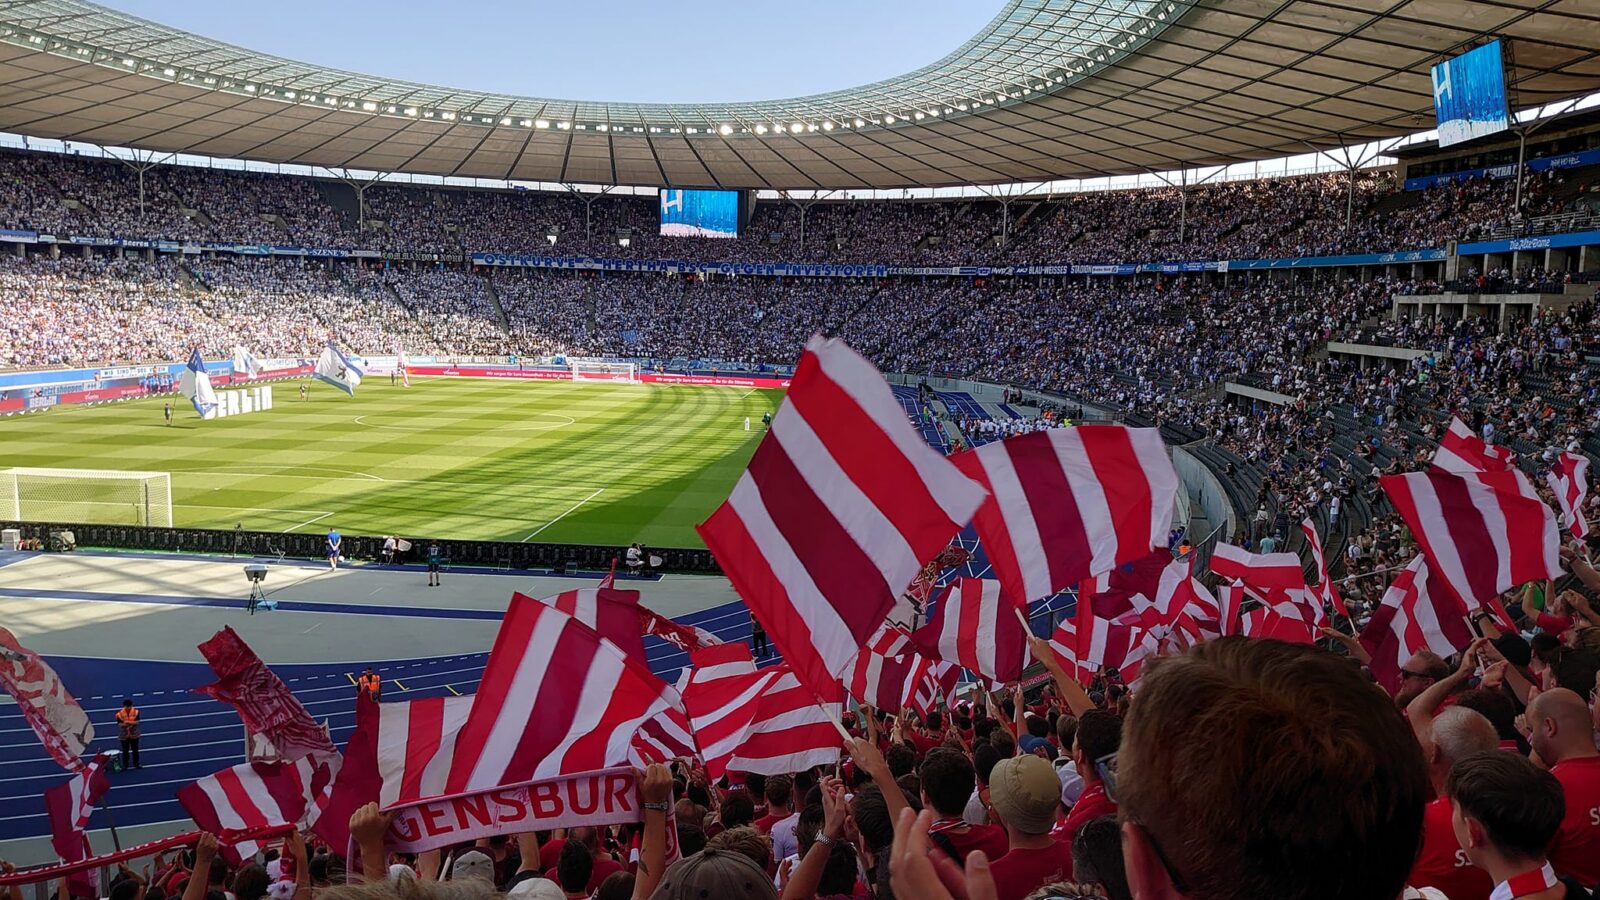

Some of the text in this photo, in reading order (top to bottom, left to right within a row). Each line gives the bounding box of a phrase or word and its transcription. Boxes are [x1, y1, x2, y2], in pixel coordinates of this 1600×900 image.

[484, 253, 576, 268] OSTKURVE
[602, 258, 669, 272] HERTHA
[677, 262, 708, 273] BSC
[720, 264, 776, 275] GEGEN
[784, 264, 886, 277] INVESTOREN
[389, 773, 640, 843] GENSBUR
[1588, 807, 1600, 826] S
